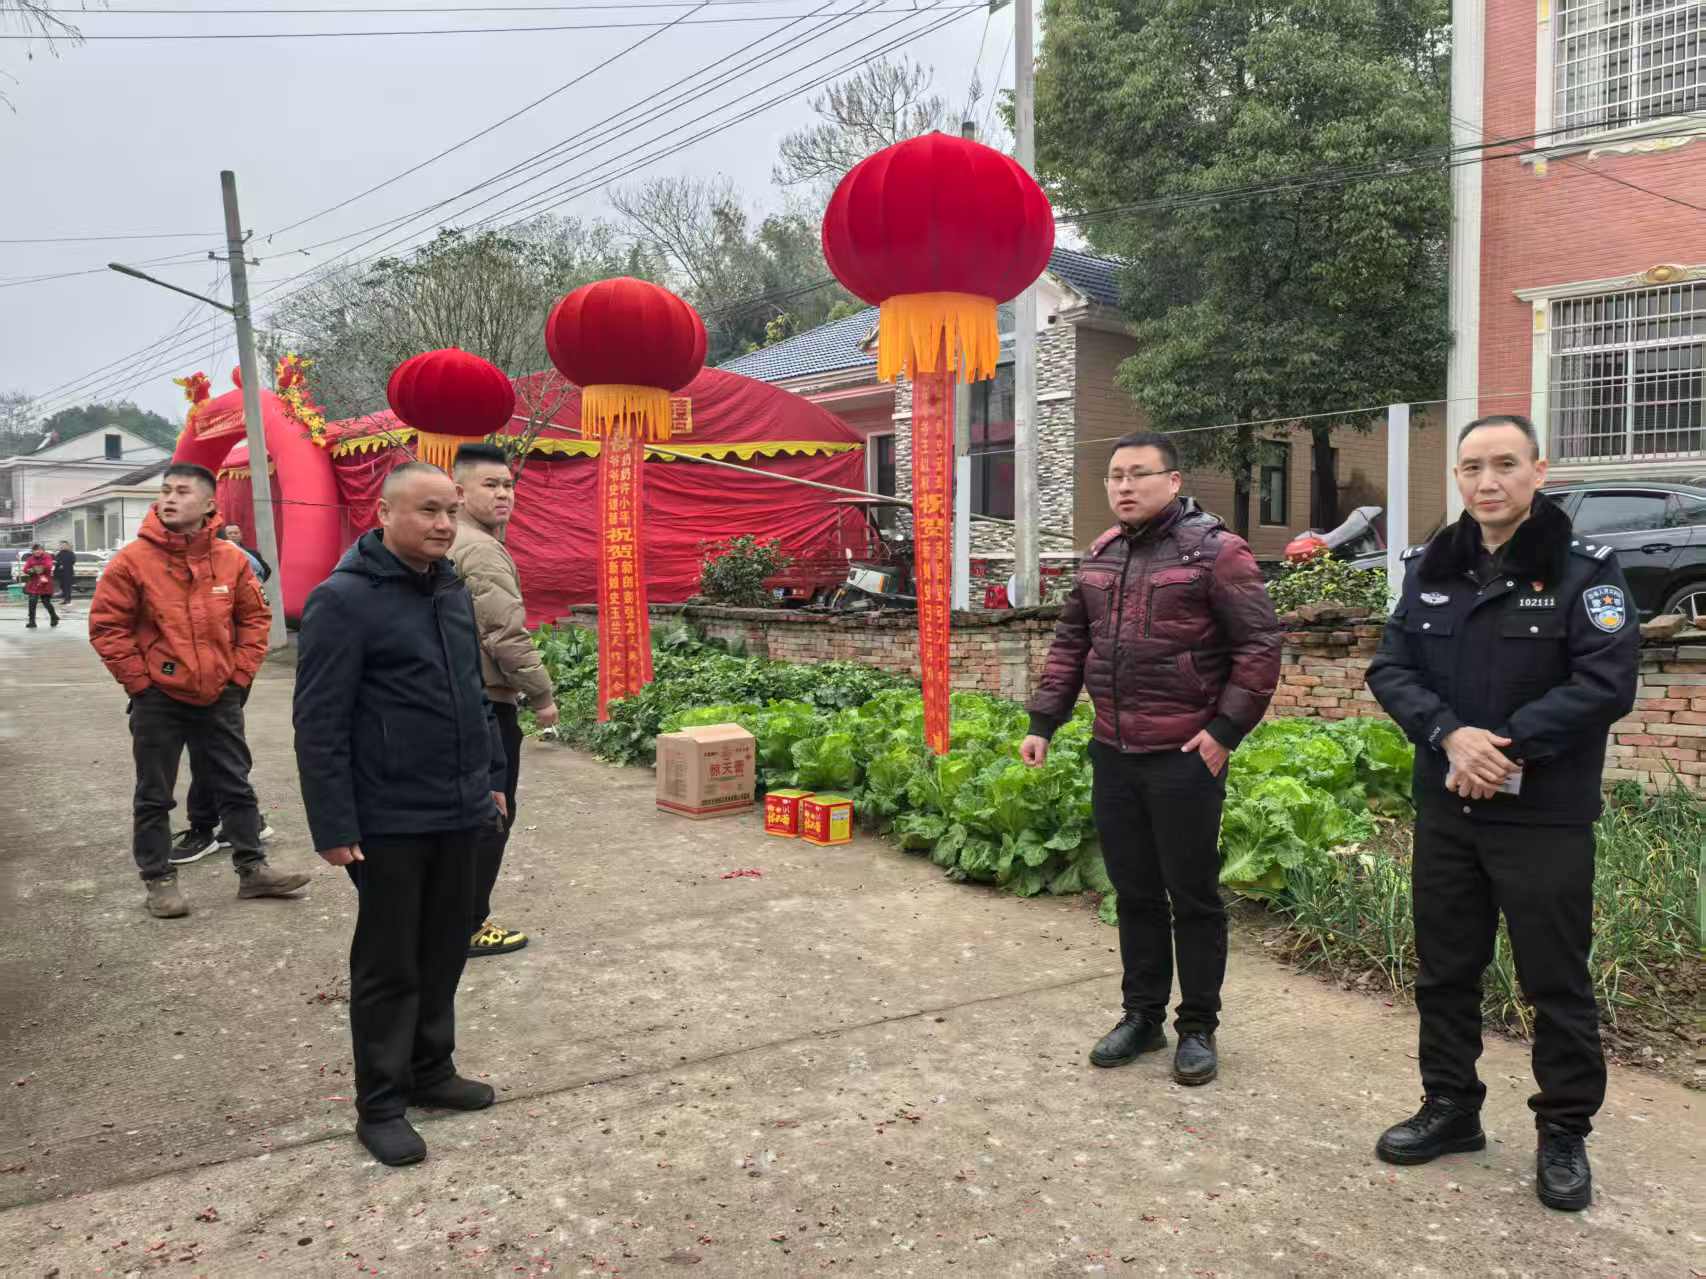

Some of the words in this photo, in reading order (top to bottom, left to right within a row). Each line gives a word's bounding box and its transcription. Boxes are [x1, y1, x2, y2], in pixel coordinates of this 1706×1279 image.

[920, 493, 944, 538] 祝贺
[606, 527, 633, 560] 祝贺
[1519, 598, 1556, 607] 102111
